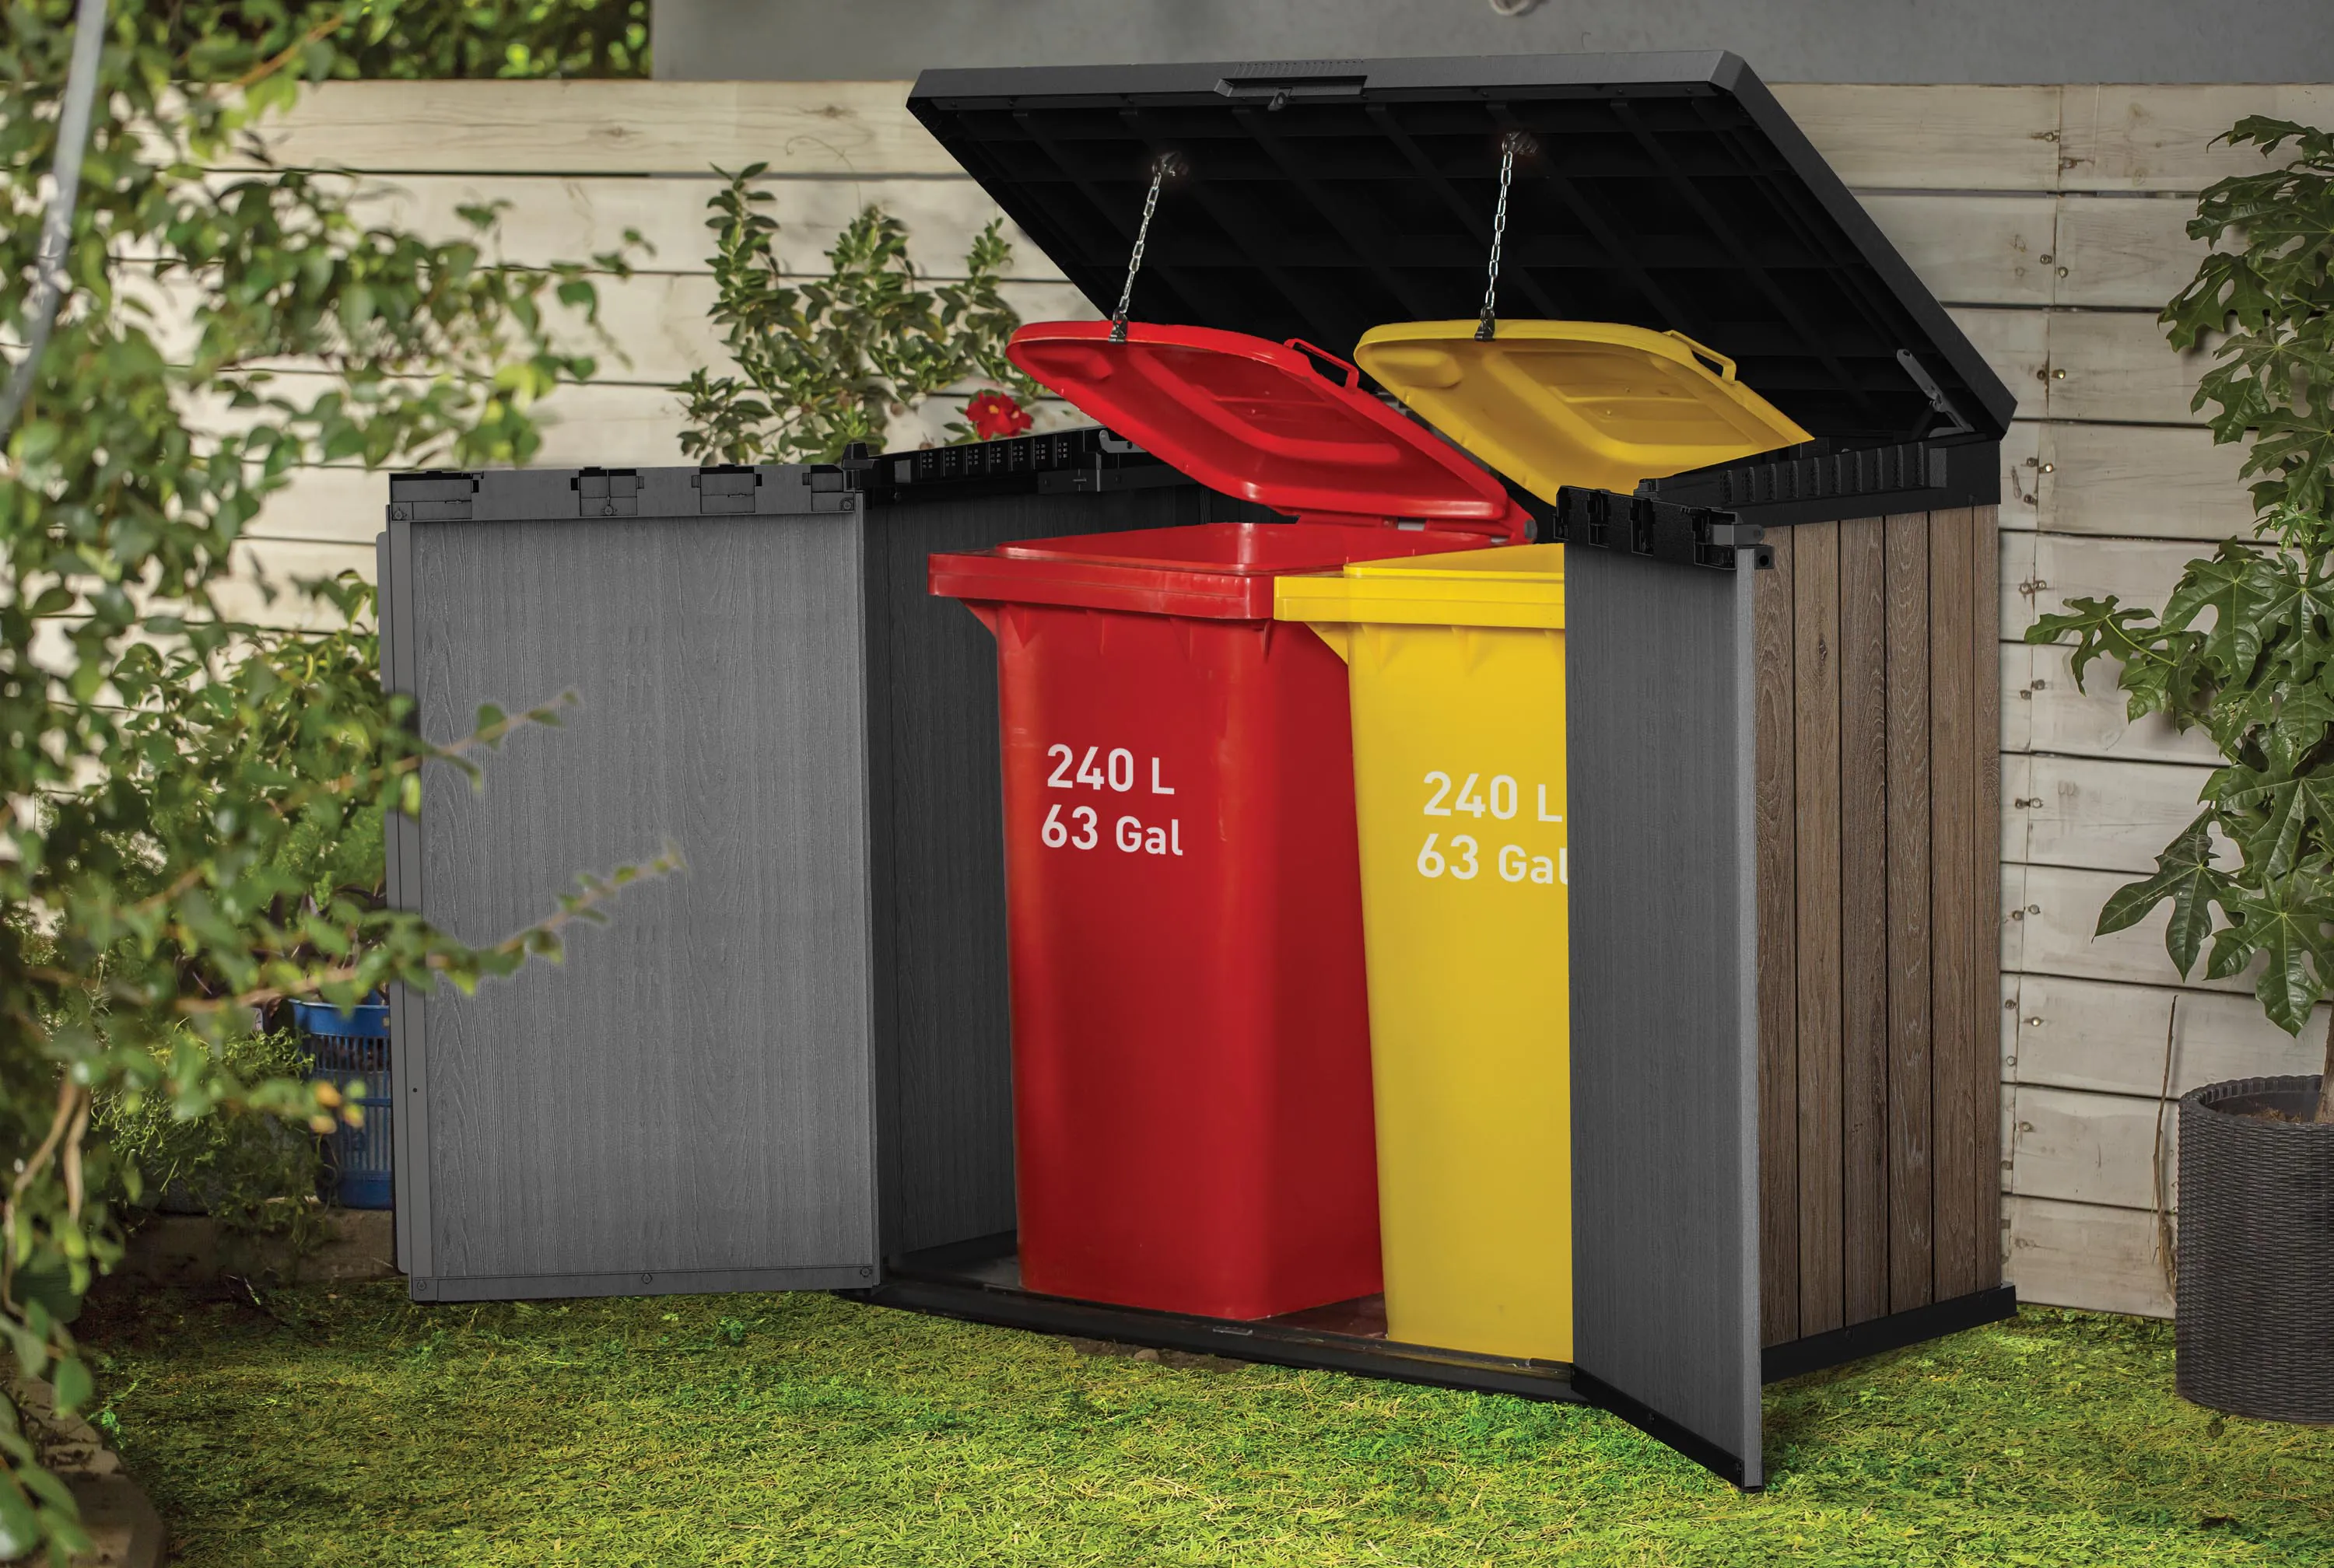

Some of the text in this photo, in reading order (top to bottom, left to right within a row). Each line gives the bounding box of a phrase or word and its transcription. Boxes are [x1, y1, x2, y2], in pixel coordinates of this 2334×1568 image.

[1047, 744, 1175, 795] 240 L
[1423, 771, 1563, 822] 240 L
[1041, 804, 1183, 856] 63 Gal
[1417, 833, 1568, 885] 63 Gal
